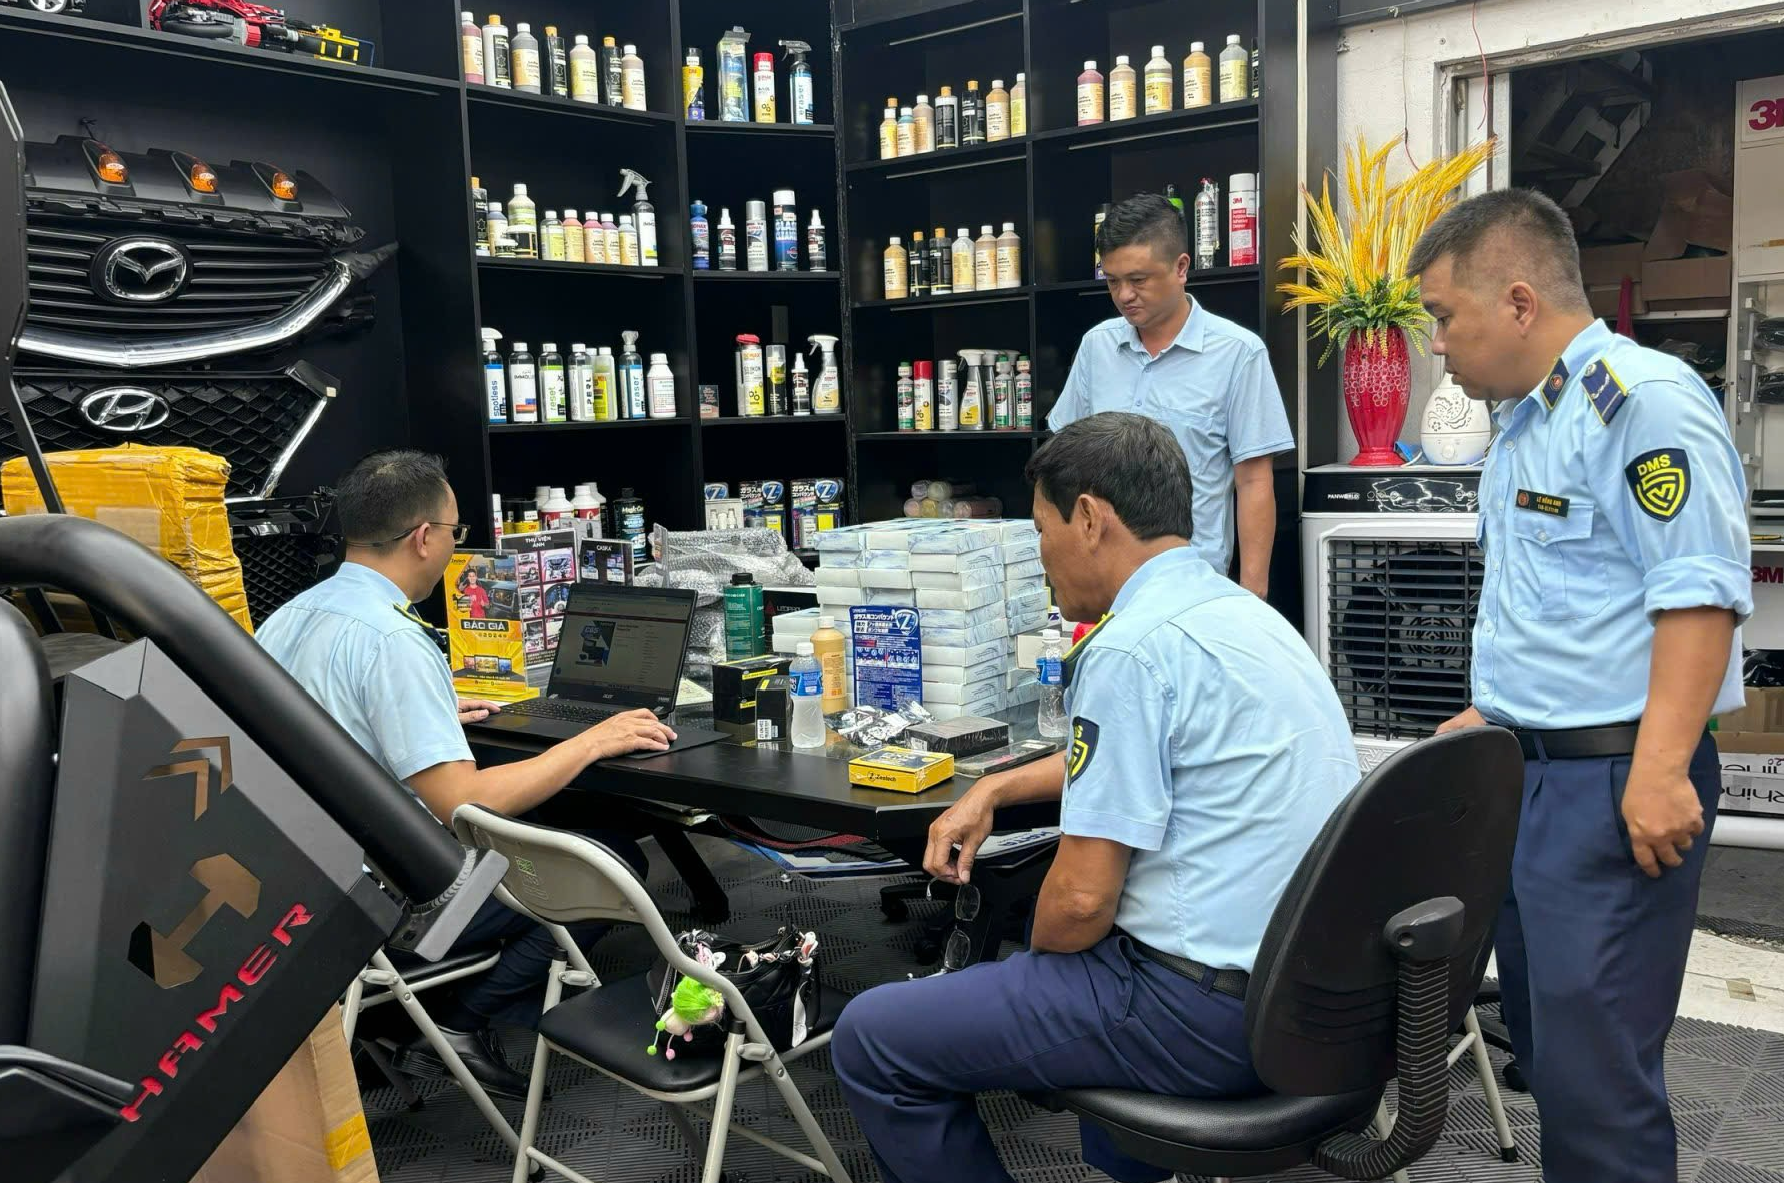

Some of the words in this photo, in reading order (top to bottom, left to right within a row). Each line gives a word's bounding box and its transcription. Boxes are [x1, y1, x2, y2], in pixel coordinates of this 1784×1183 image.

[491, 380, 499, 417] spotless
[1637, 454, 1671, 477] DMS
[538, 535, 552, 543] VIỆN
[1751, 567, 1784, 584] 3M
[463, 620, 486, 630] BÁO
[488, 621, 506, 631] GIÁ
[876, 774, 896, 782] Zestech
